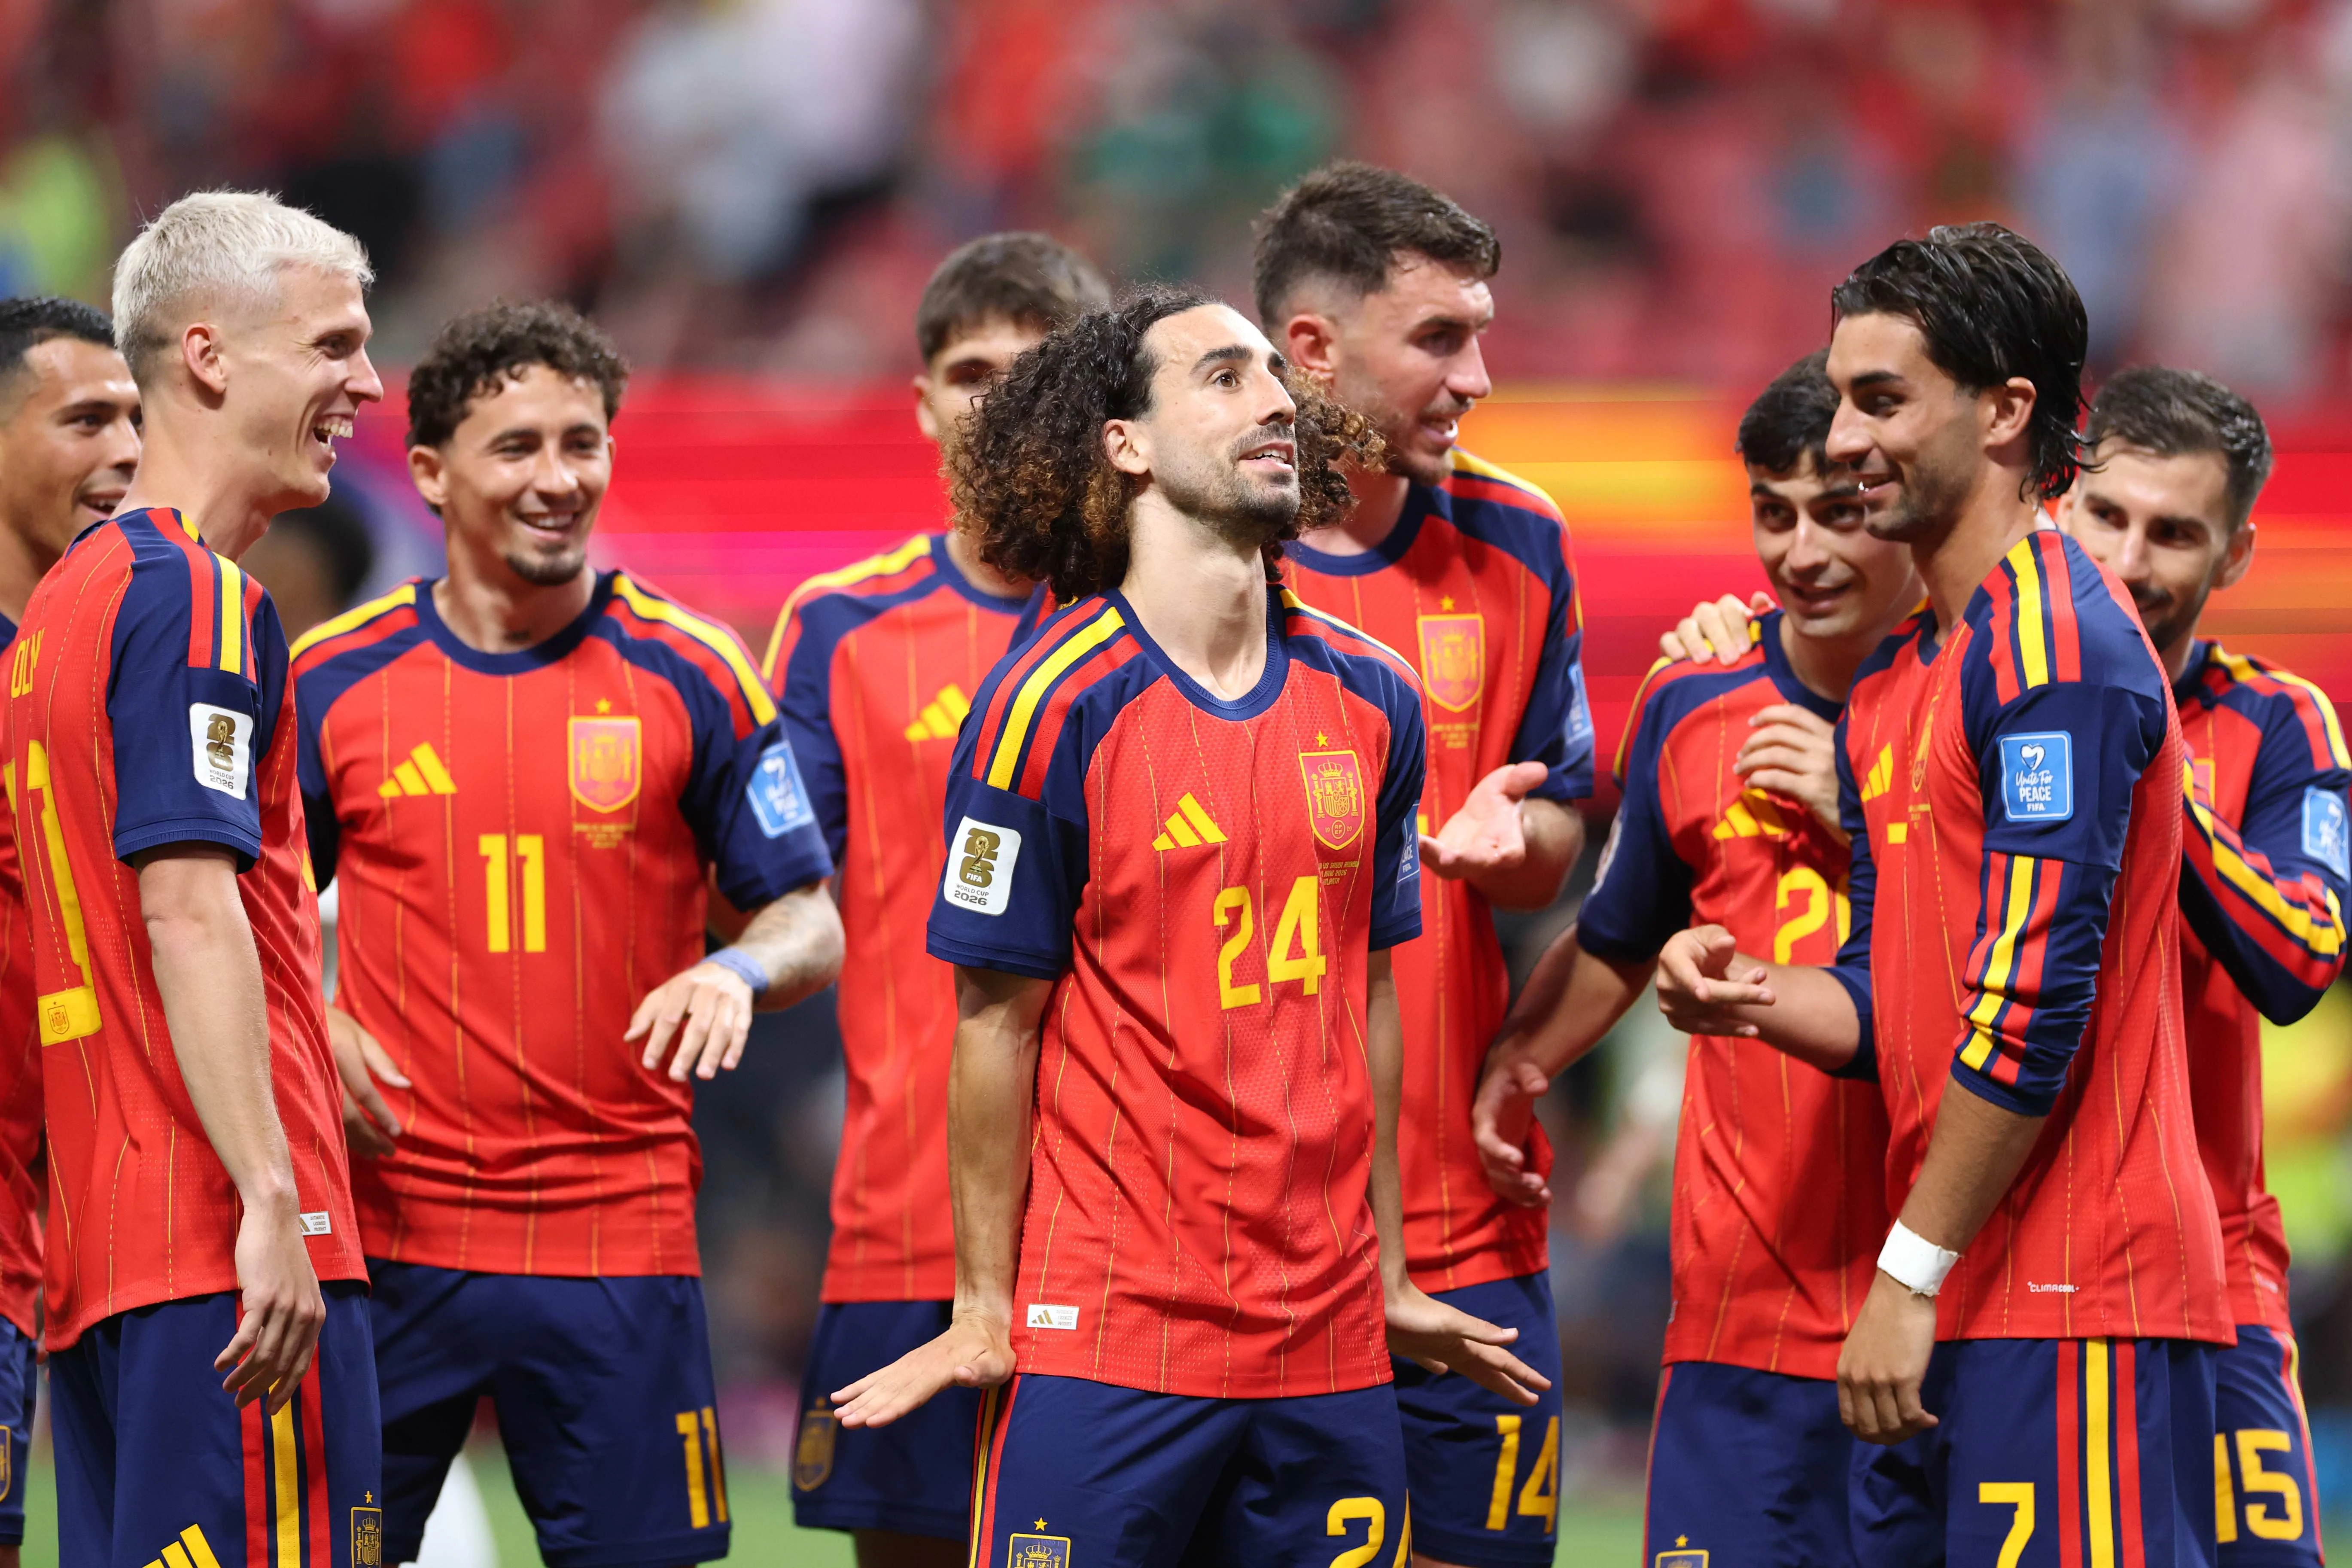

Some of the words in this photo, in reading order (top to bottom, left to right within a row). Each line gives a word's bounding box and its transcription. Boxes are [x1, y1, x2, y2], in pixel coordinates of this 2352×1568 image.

[215, 758, 228, 767] FIFA
[210, 769, 225, 778] WORLD
[2015, 770, 2039, 788] Unite
[2038, 769, 2054, 786] For
[210, 775, 234, 790] 2026
[2019, 786, 2052, 803] PEACE
[2026, 802, 2045, 812] FIFA
[966, 873, 983, 883] FIFA
[478, 834, 546, 953] 11
[956, 883, 975, 894] WORLD
[954, 890, 987, 906] 2026
[1213, 875, 1327, 1010] 24
[2030, 1283, 2075, 1293] CLIMACOOL
[675, 1406, 728, 1528] 11
[1485, 1415, 1560, 1534] 14
[2214, 1428, 2303, 1544] 15
[1979, 1483, 2035, 1568] 7
